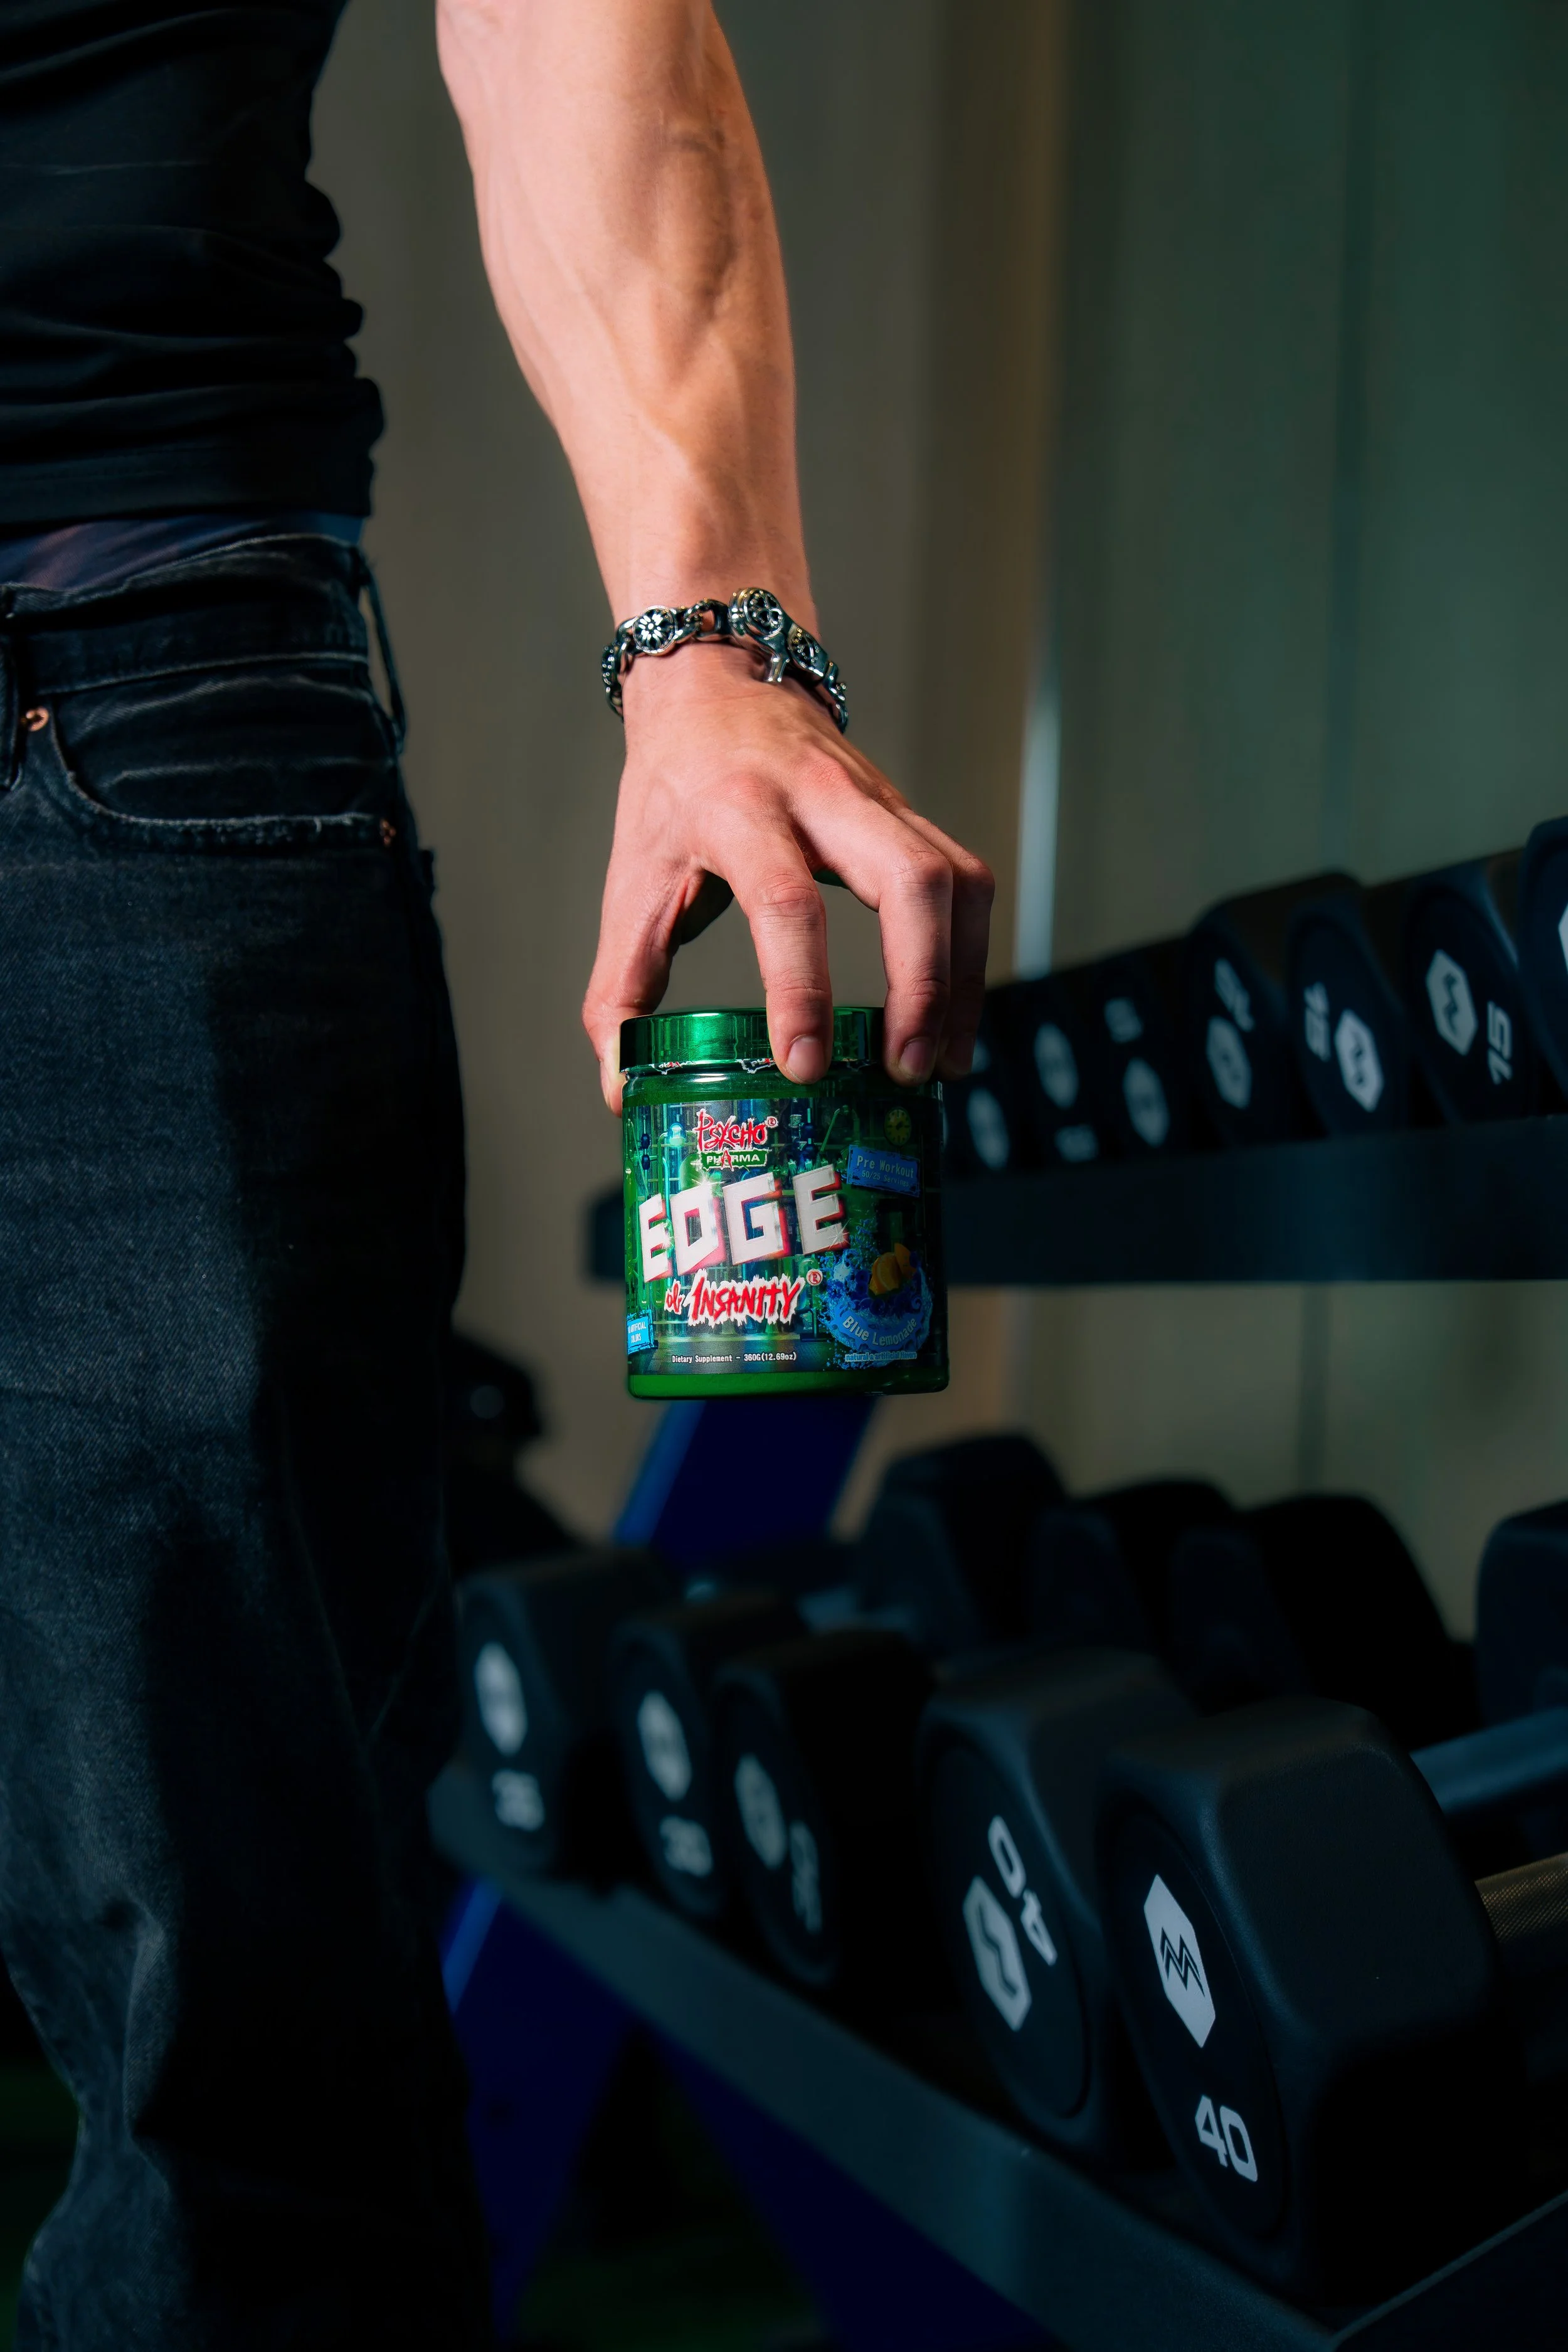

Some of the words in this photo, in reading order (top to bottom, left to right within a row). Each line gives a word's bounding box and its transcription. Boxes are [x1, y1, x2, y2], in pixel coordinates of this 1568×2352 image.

[1486, 1000, 1513, 1086] 15
[706, 1150, 760, 1170] PHARMA
[856, 1155, 875, 1169] Pre
[879, 1159, 914, 1179] Workout
[862, 1170, 881, 1180] 50/25
[638, 1164, 847, 1283] EDGE
[842, 1316, 869, 1341] Blue
[872, 1318, 917, 1346] Lemonade
[672, 1355, 692, 1364] Dietary
[695, 1354, 733, 1364] Supplement
[744, 1352, 797, 1362] 360G(12.69oz)
[845, 1353, 869, 1361] natural
[987, 1814, 1059, 1966] 40
[1194, 2094, 1259, 2183] 40
